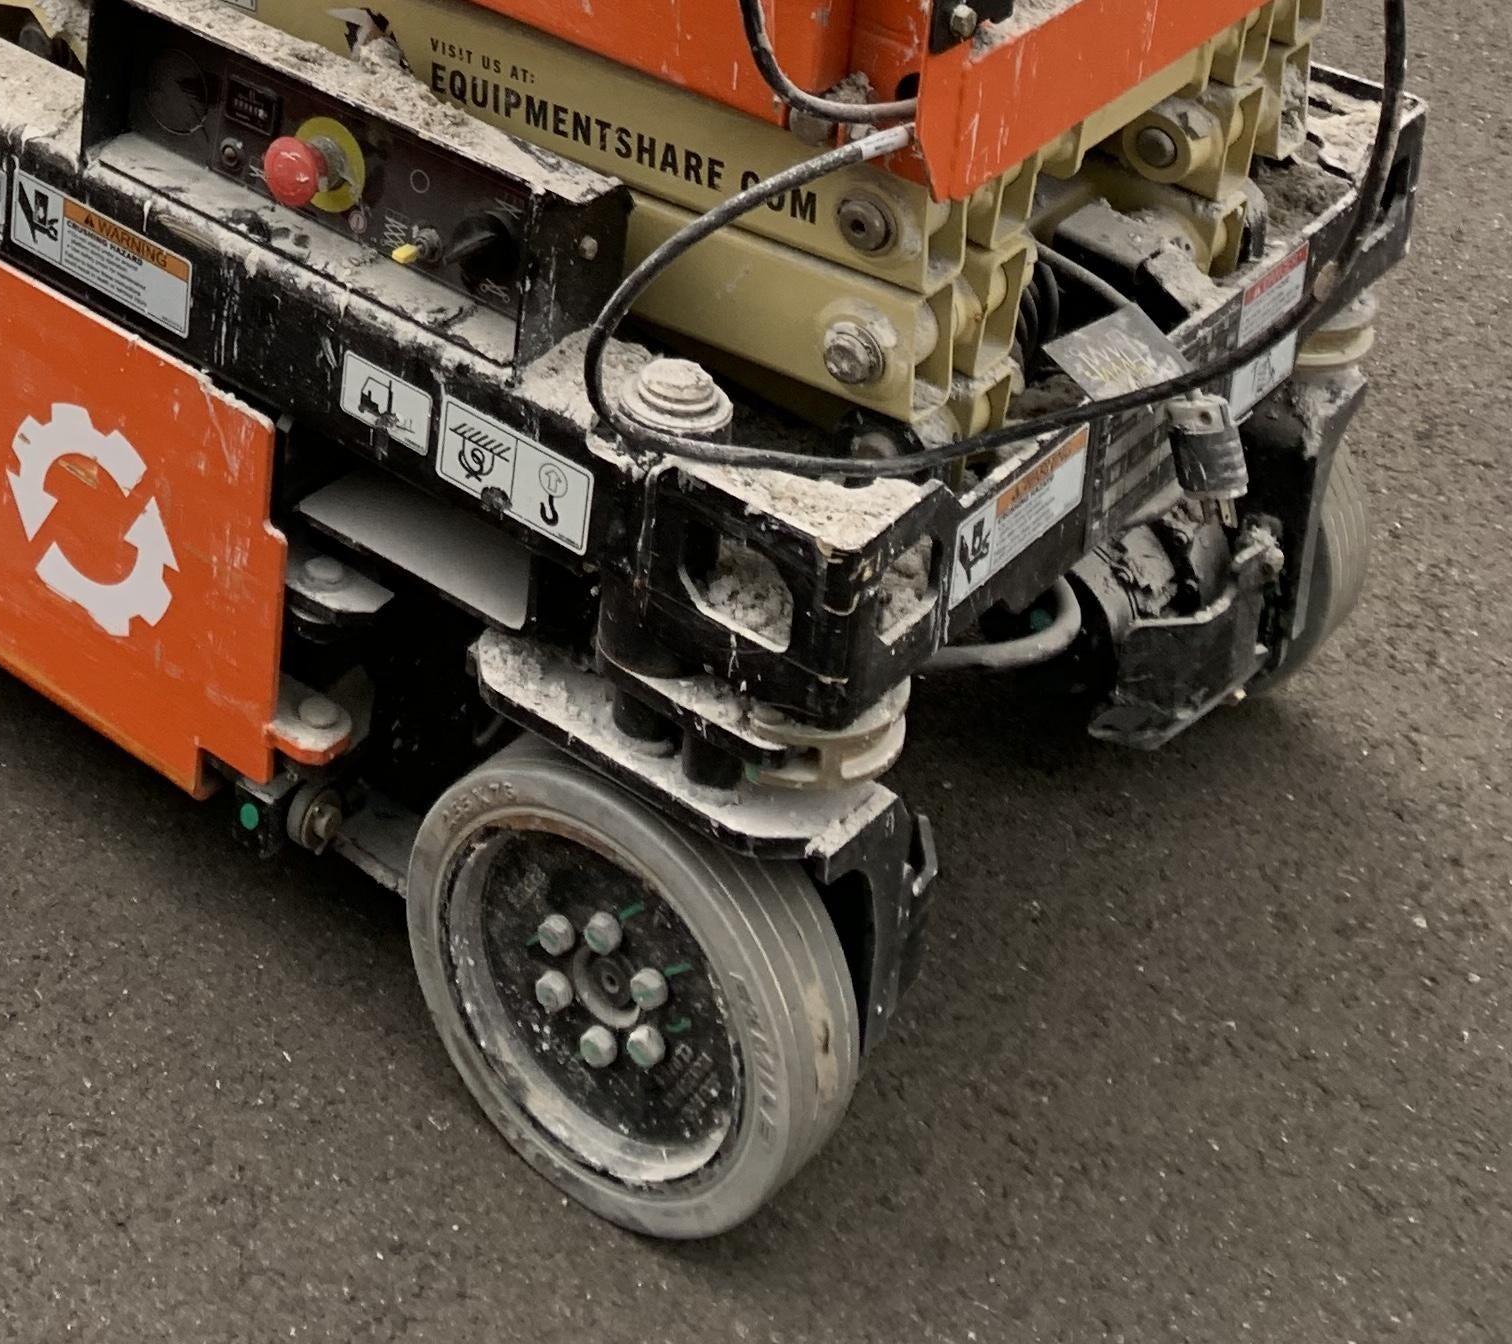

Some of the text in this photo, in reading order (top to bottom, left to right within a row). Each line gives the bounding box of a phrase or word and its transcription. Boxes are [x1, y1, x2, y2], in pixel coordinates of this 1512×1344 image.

[430, 37, 535, 85] VISIT US AT:
[98, 218, 168, 268] WARNING
